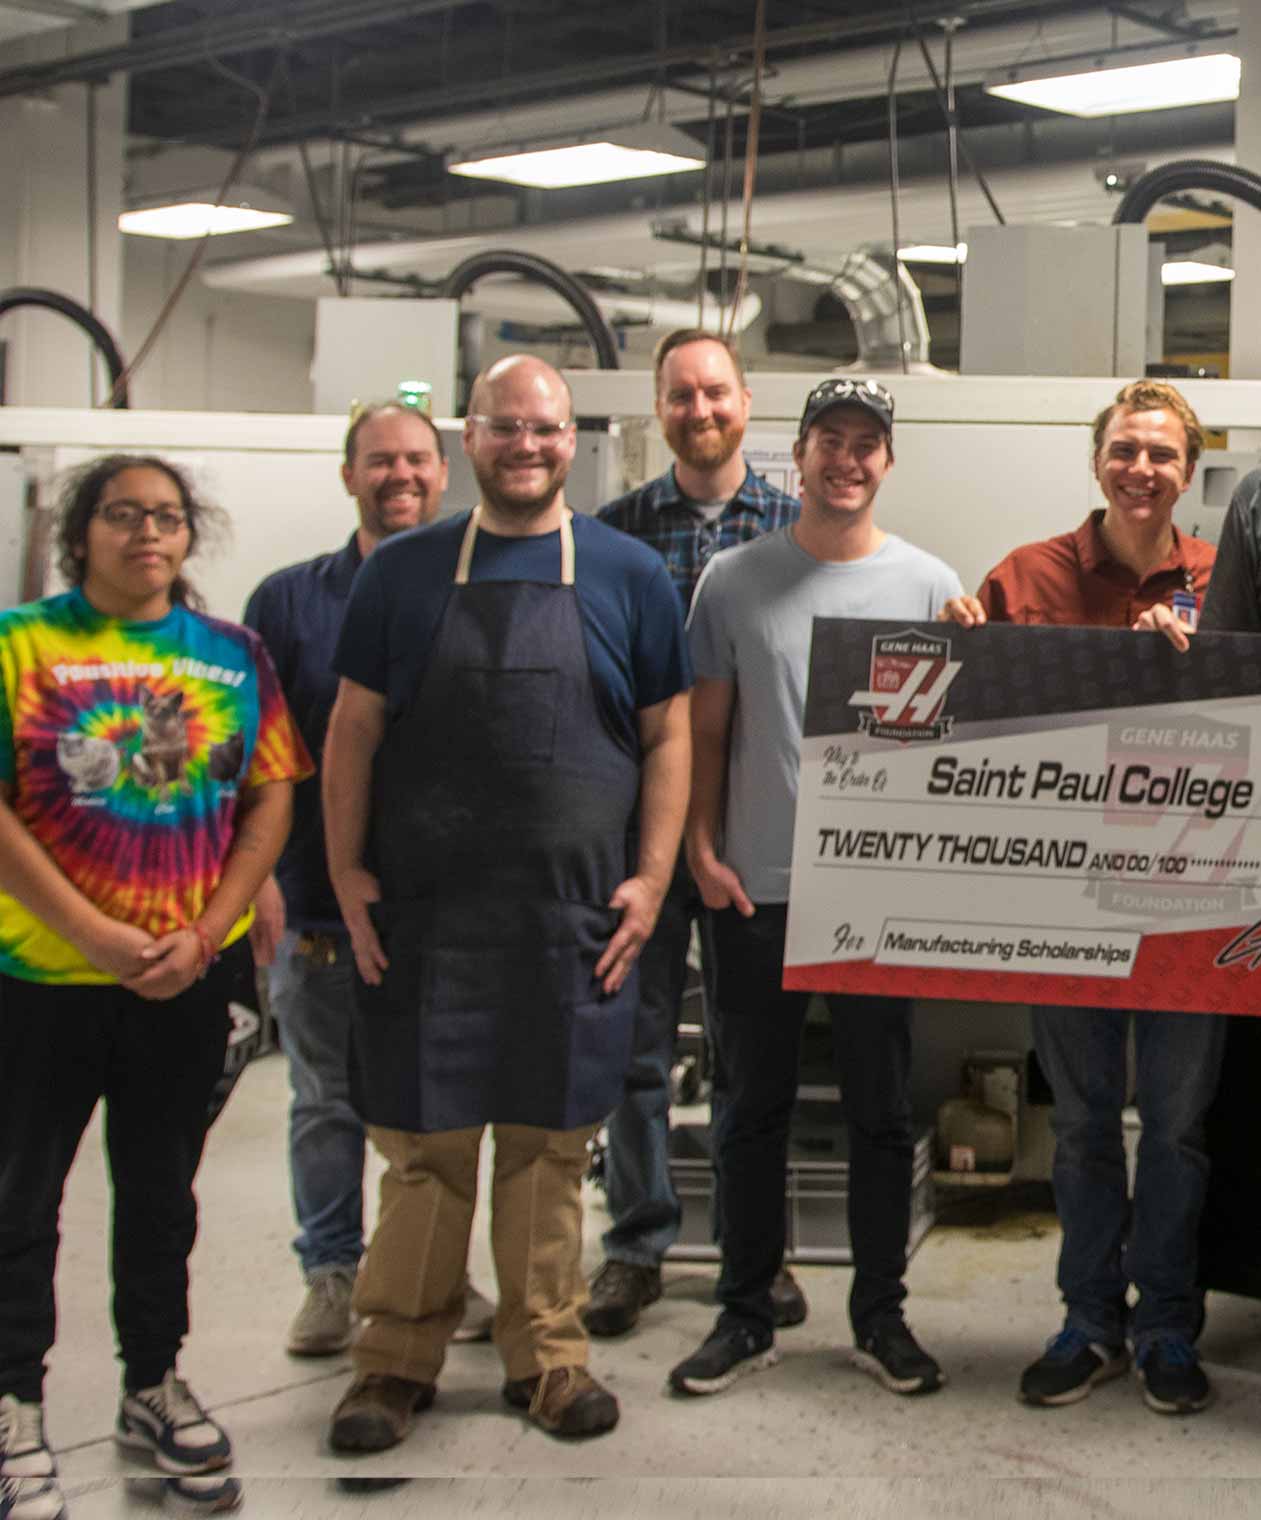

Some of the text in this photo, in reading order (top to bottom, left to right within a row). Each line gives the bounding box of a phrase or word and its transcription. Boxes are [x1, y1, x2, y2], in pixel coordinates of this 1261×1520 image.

[1119, 727, 1241, 749] GENE HAAS
[927, 755, 1254, 819] Saint Paul College
[817, 828, 933, 861] TWENTY
[937, 834, 1088, 869] THOUSAND
[1088, 853, 1125, 872] AND
[1112, 892, 1225, 912] FOUNDATION
[884, 933, 1014, 960] Manufacturing
[1017, 940, 1131, 965] Scholarships
